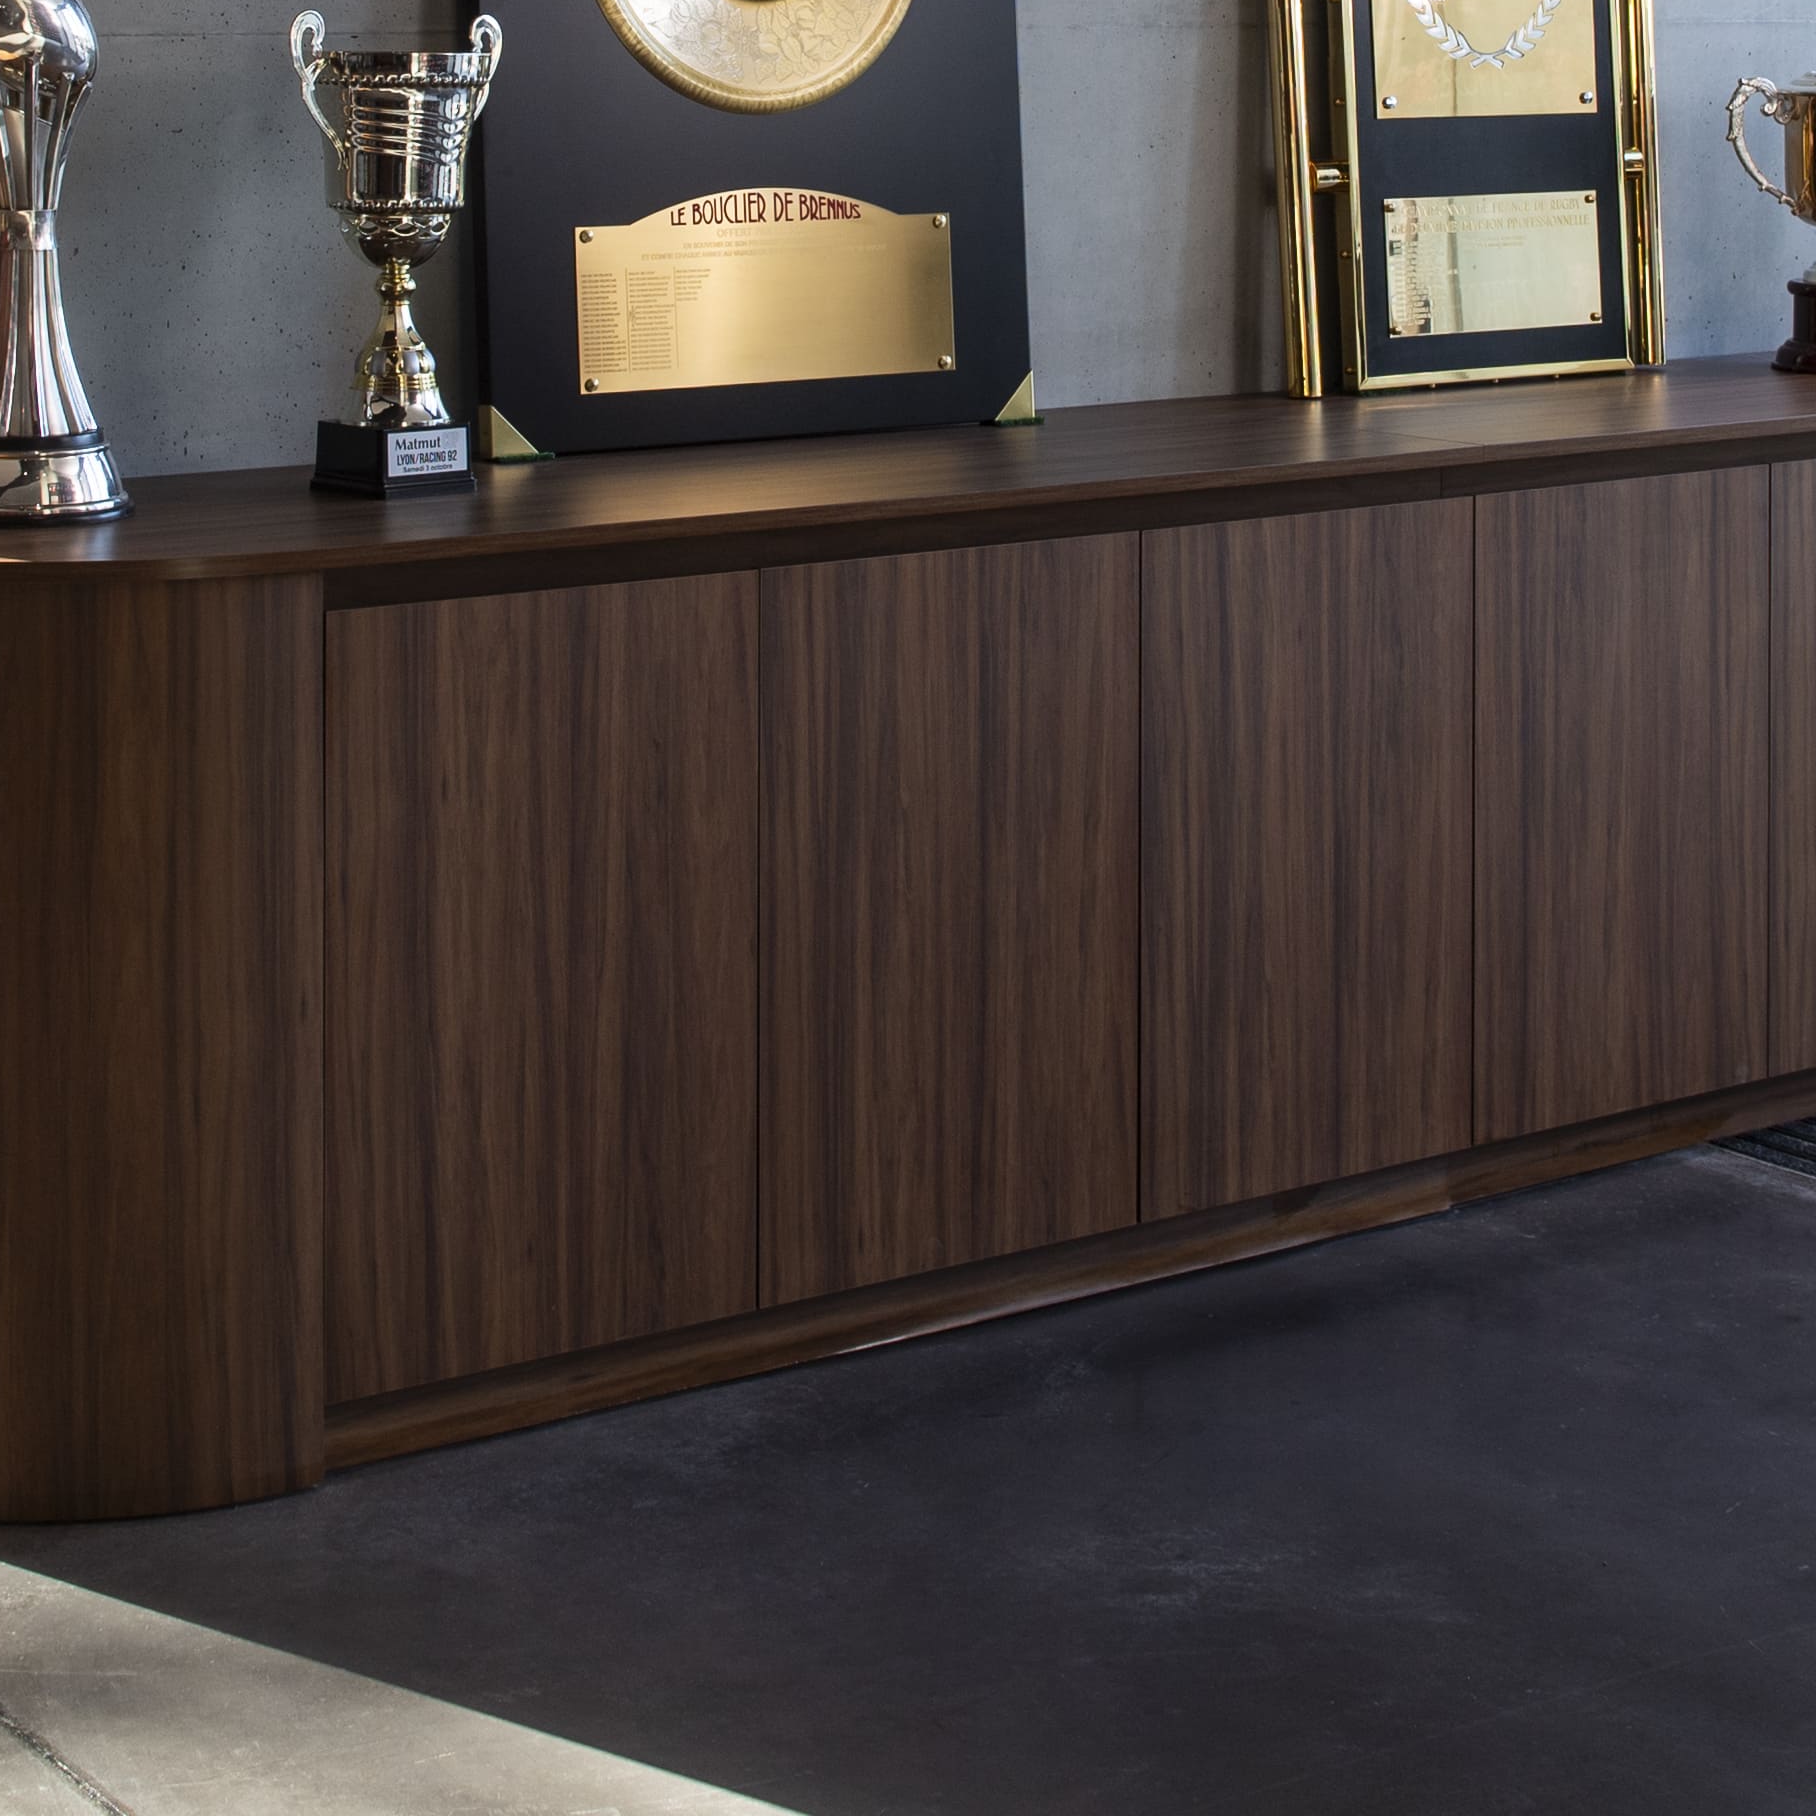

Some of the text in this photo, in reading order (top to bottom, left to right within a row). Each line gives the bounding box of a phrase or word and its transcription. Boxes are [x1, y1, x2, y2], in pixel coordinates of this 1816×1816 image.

[670, 191, 862, 227] LE BOUCLIER DE BRENNUS
[395, 436, 441, 451] Matmut
[447, 449, 458, 462] 92
